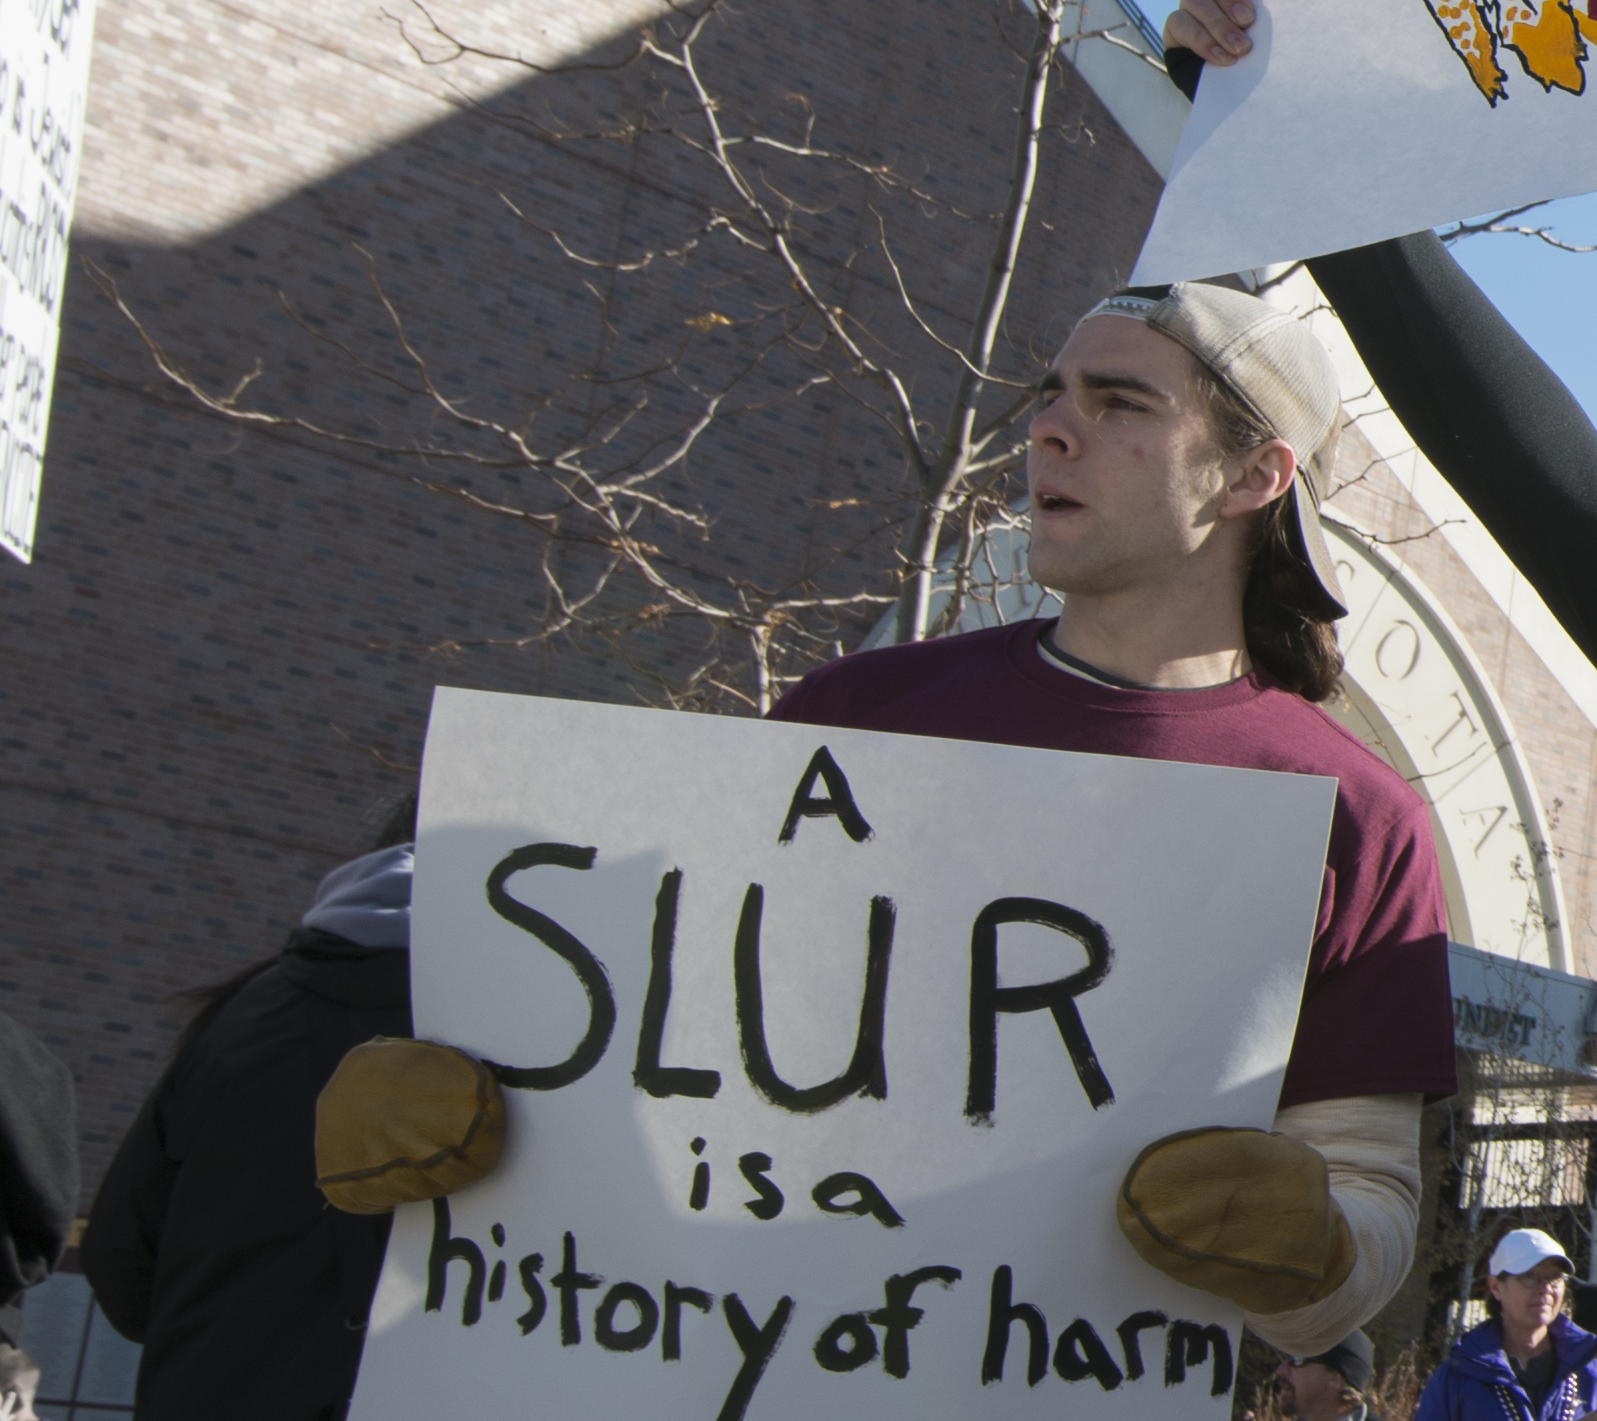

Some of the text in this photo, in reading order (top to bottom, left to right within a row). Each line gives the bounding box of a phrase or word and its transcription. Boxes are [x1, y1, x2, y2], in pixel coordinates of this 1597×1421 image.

[780, 746, 872, 843] A
[483, 843, 1113, 1126] SLUR
[689, 1138, 904, 1228] is a
[814, 1266, 962, 1379] of
[982, 1264, 1235, 1396] harm
